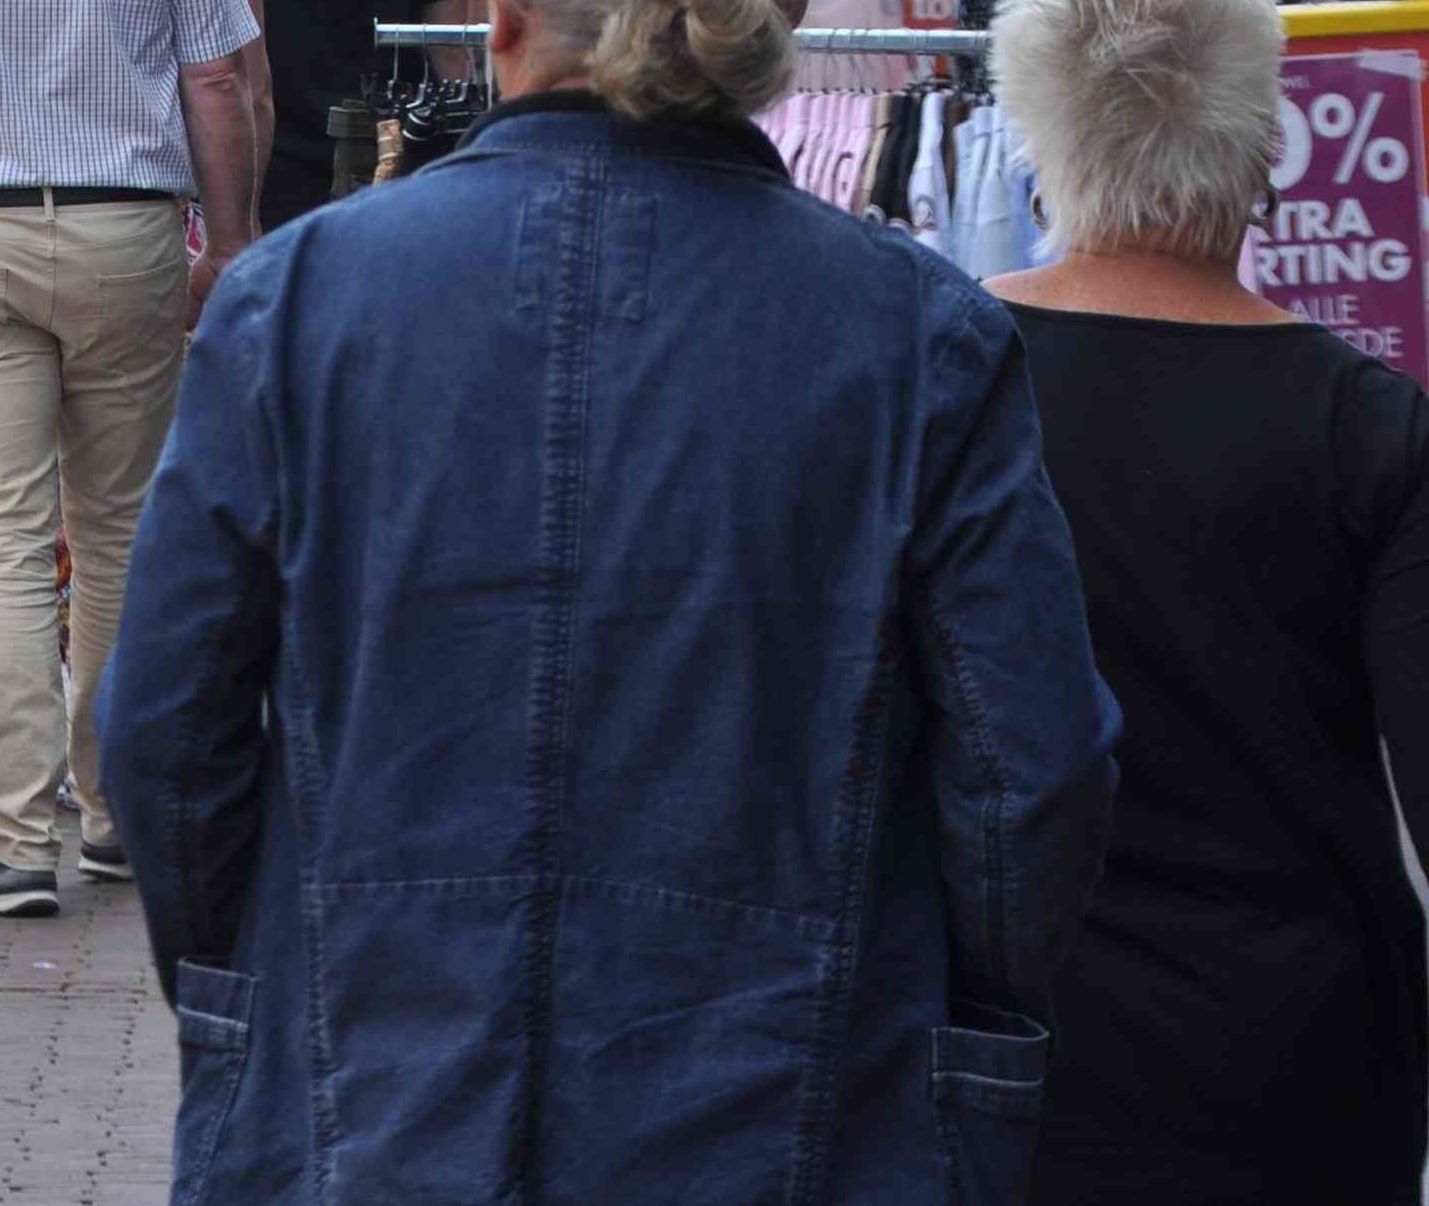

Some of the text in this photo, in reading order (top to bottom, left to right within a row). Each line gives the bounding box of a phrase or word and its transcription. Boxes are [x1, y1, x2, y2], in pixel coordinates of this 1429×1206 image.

[1269, 92, 1410, 191] 0%
[1253, 198, 1375, 243] TRA
[1256, 239, 1412, 287] RTING
